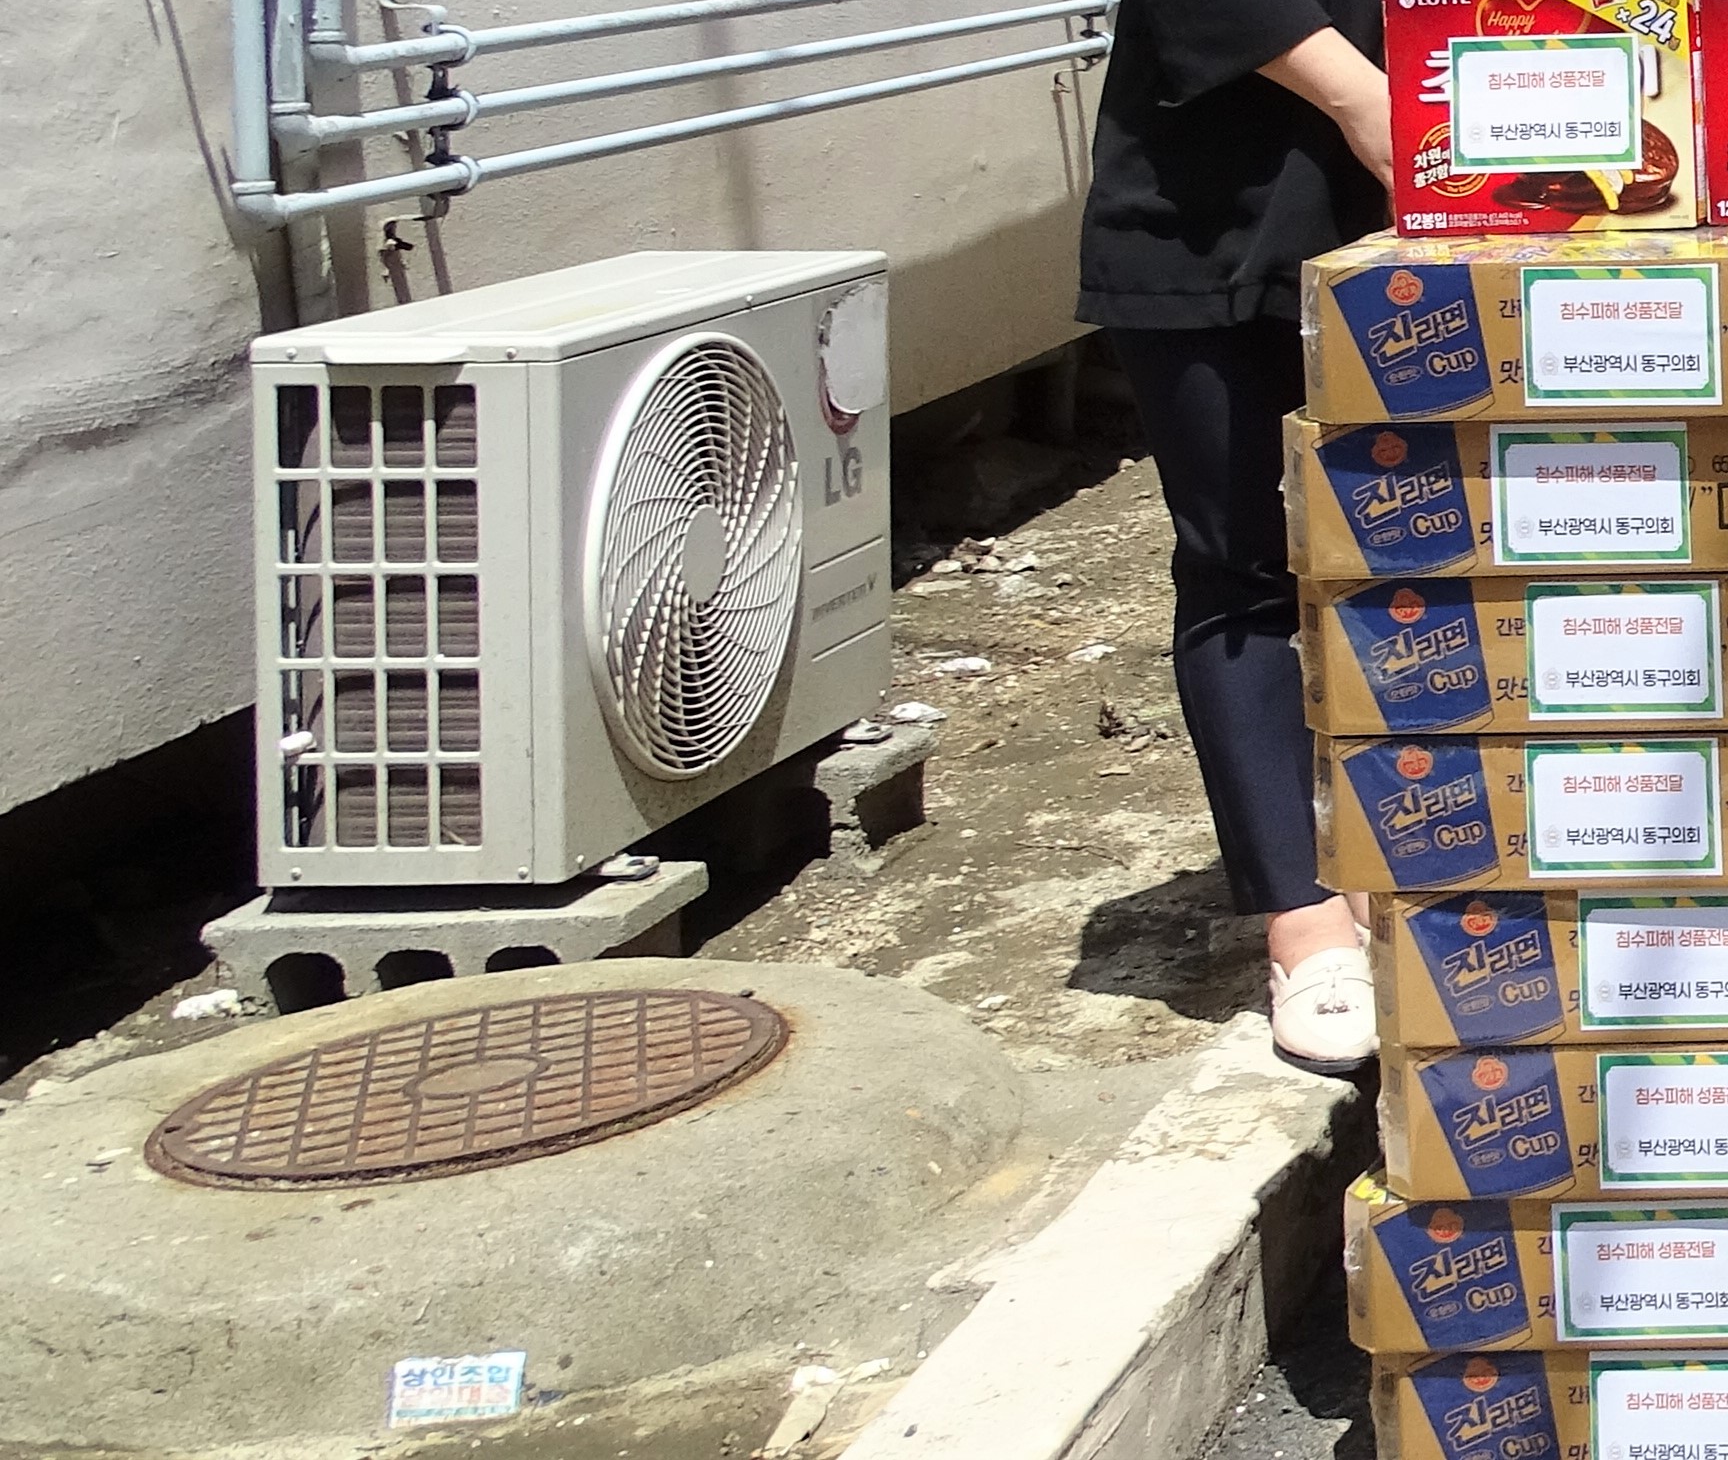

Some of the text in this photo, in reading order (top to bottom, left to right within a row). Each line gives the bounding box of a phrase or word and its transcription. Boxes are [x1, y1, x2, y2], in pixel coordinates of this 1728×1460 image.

[1488, 12, 1535, 33] Happy
[1488, 70, 1605, 90] 침수피해 성품전달
[1490, 122, 1621, 140] 부산광역시 동구의회
[1403, 213, 1447, 230] 12봉입
[1428, 346, 1476, 376] Cup
[824, 447, 862, 507] LG
[1428, 663, 1477, 693] Cup
[1509, 1130, 1559, 1161] Cup
